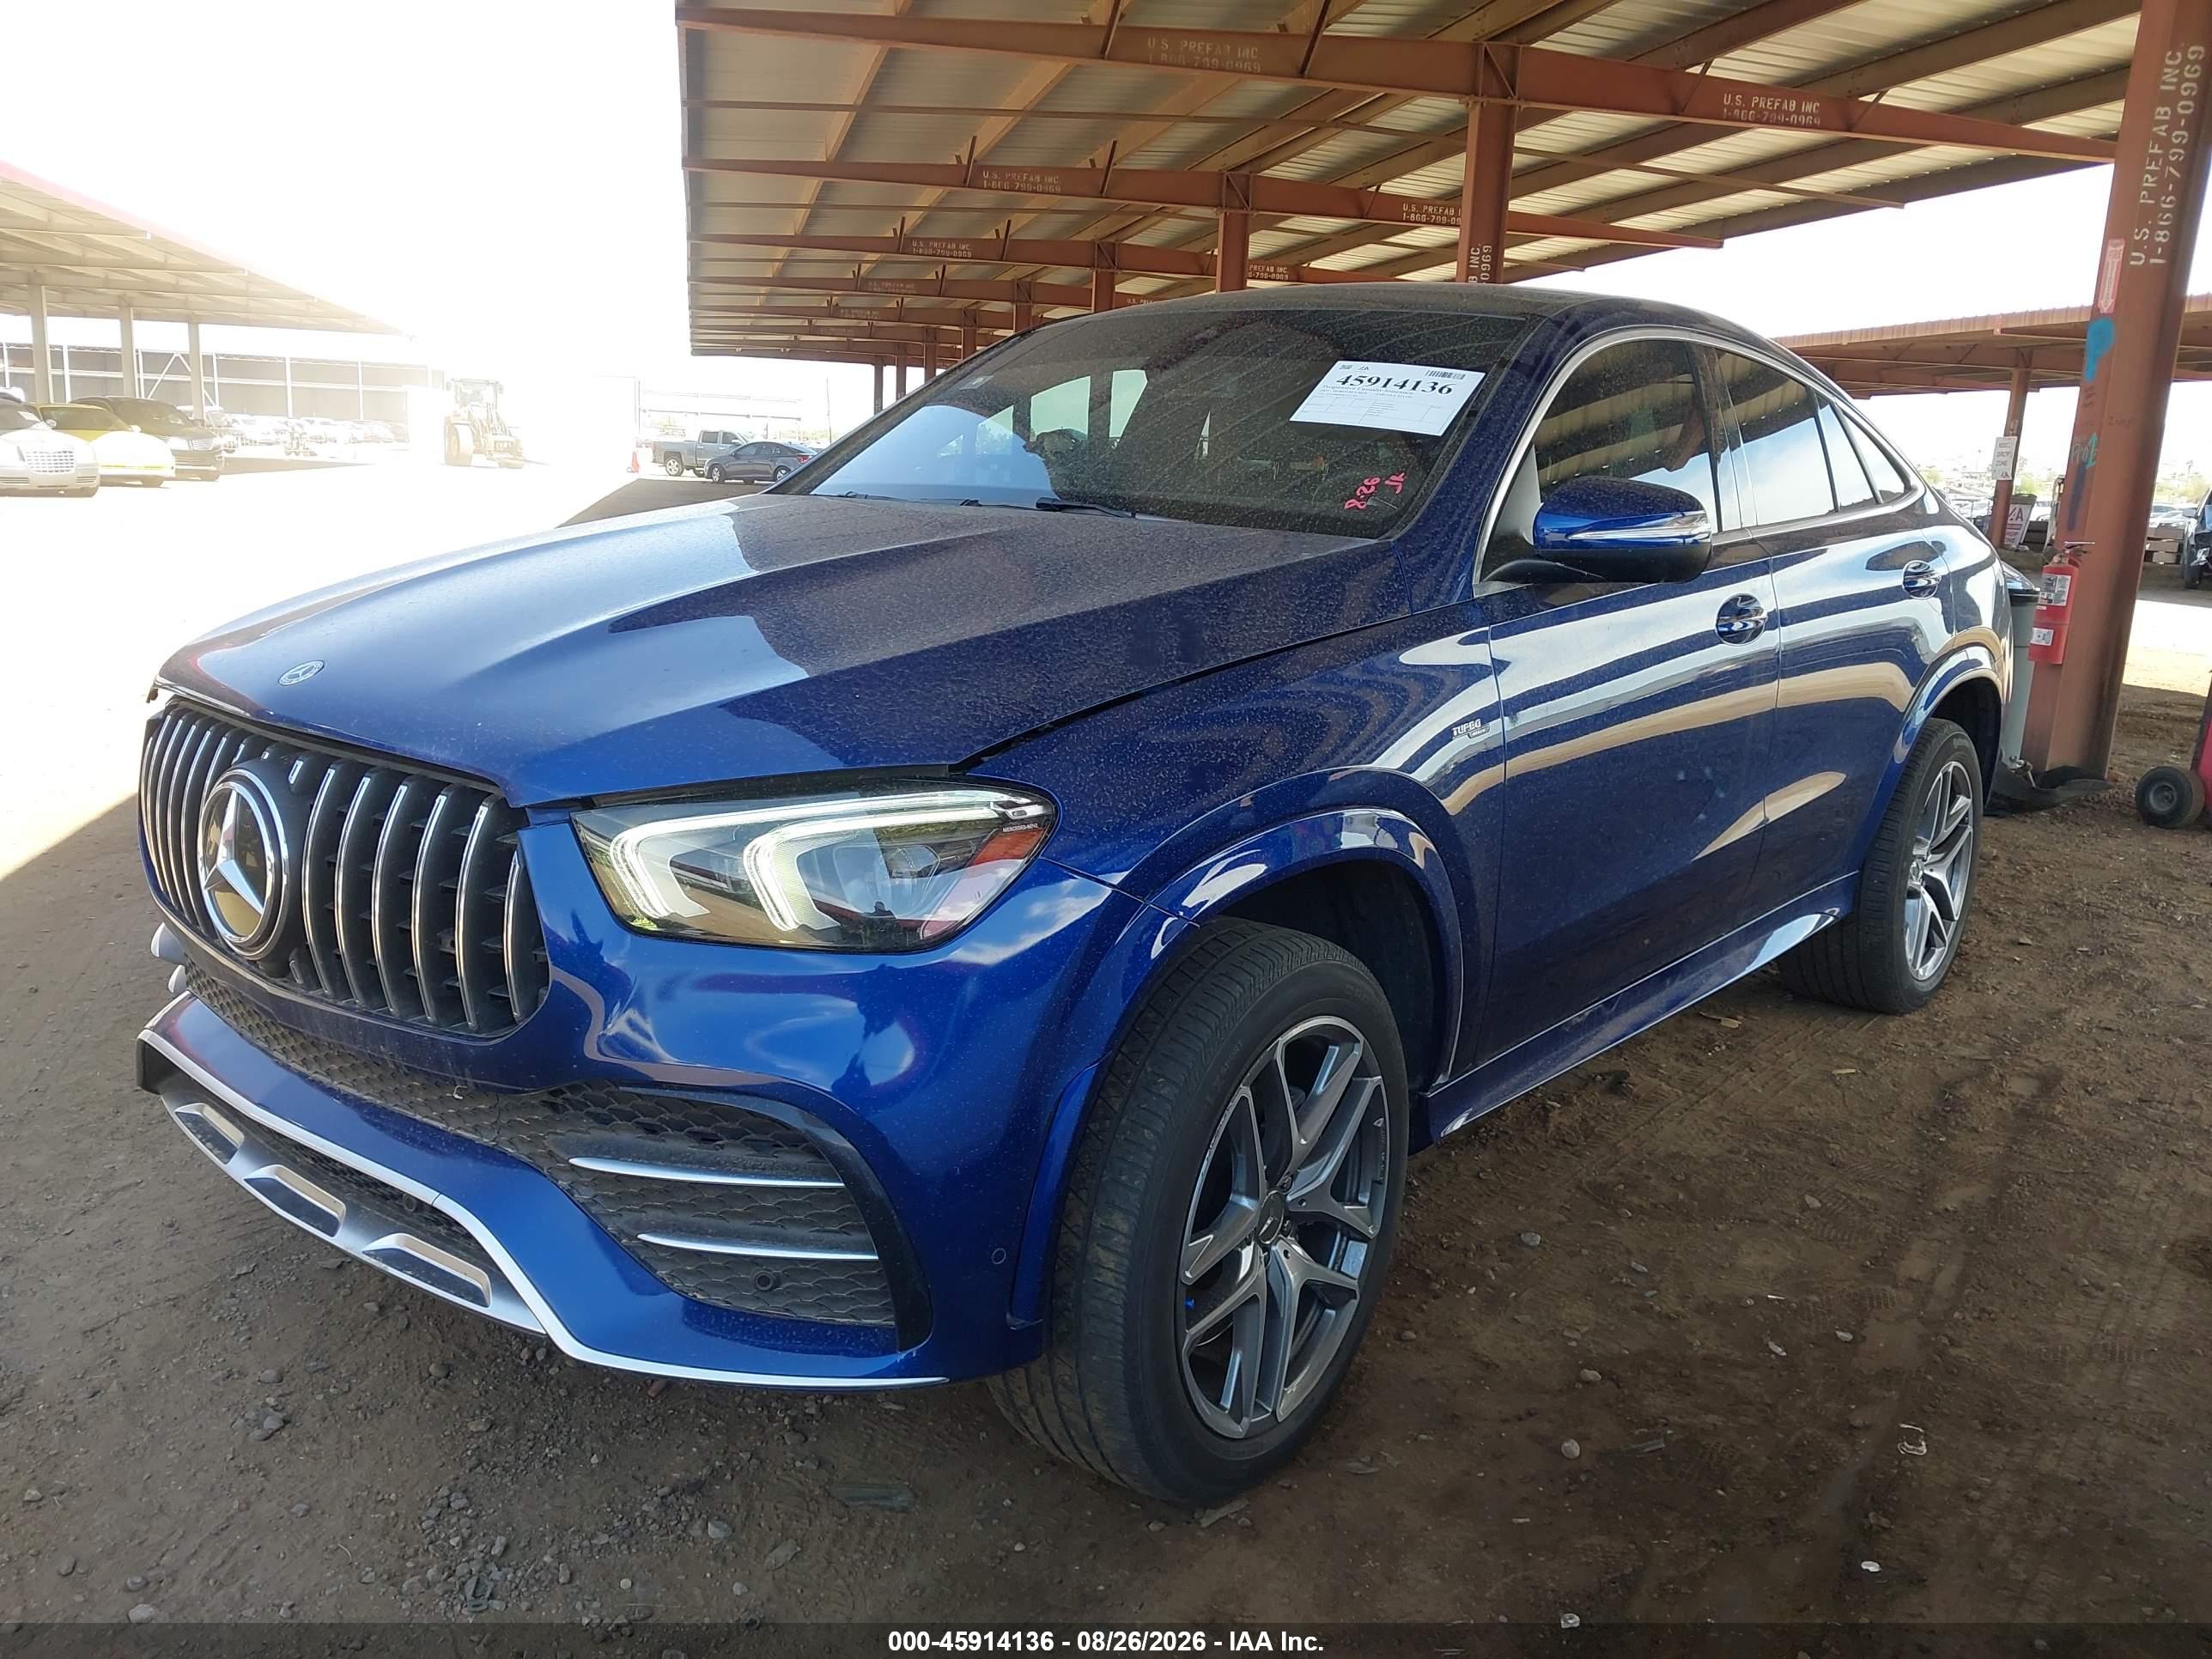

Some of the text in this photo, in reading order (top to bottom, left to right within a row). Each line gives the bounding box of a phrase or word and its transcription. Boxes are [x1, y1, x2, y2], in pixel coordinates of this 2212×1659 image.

[1723, 93, 1746, 106] U.S.
[1752, 96, 1796, 112] PREFAB
[2139, 106, 2172, 204] PREFAB
[2149, 45, 2205, 265] 1-866-799-0969
[1402, 203, 1419, 213] U.S.
[1423, 205, 1455, 216] PREFAB
[2130, 220, 2153, 266] U.S.
[1336, 374, 1457, 395] 45914136
